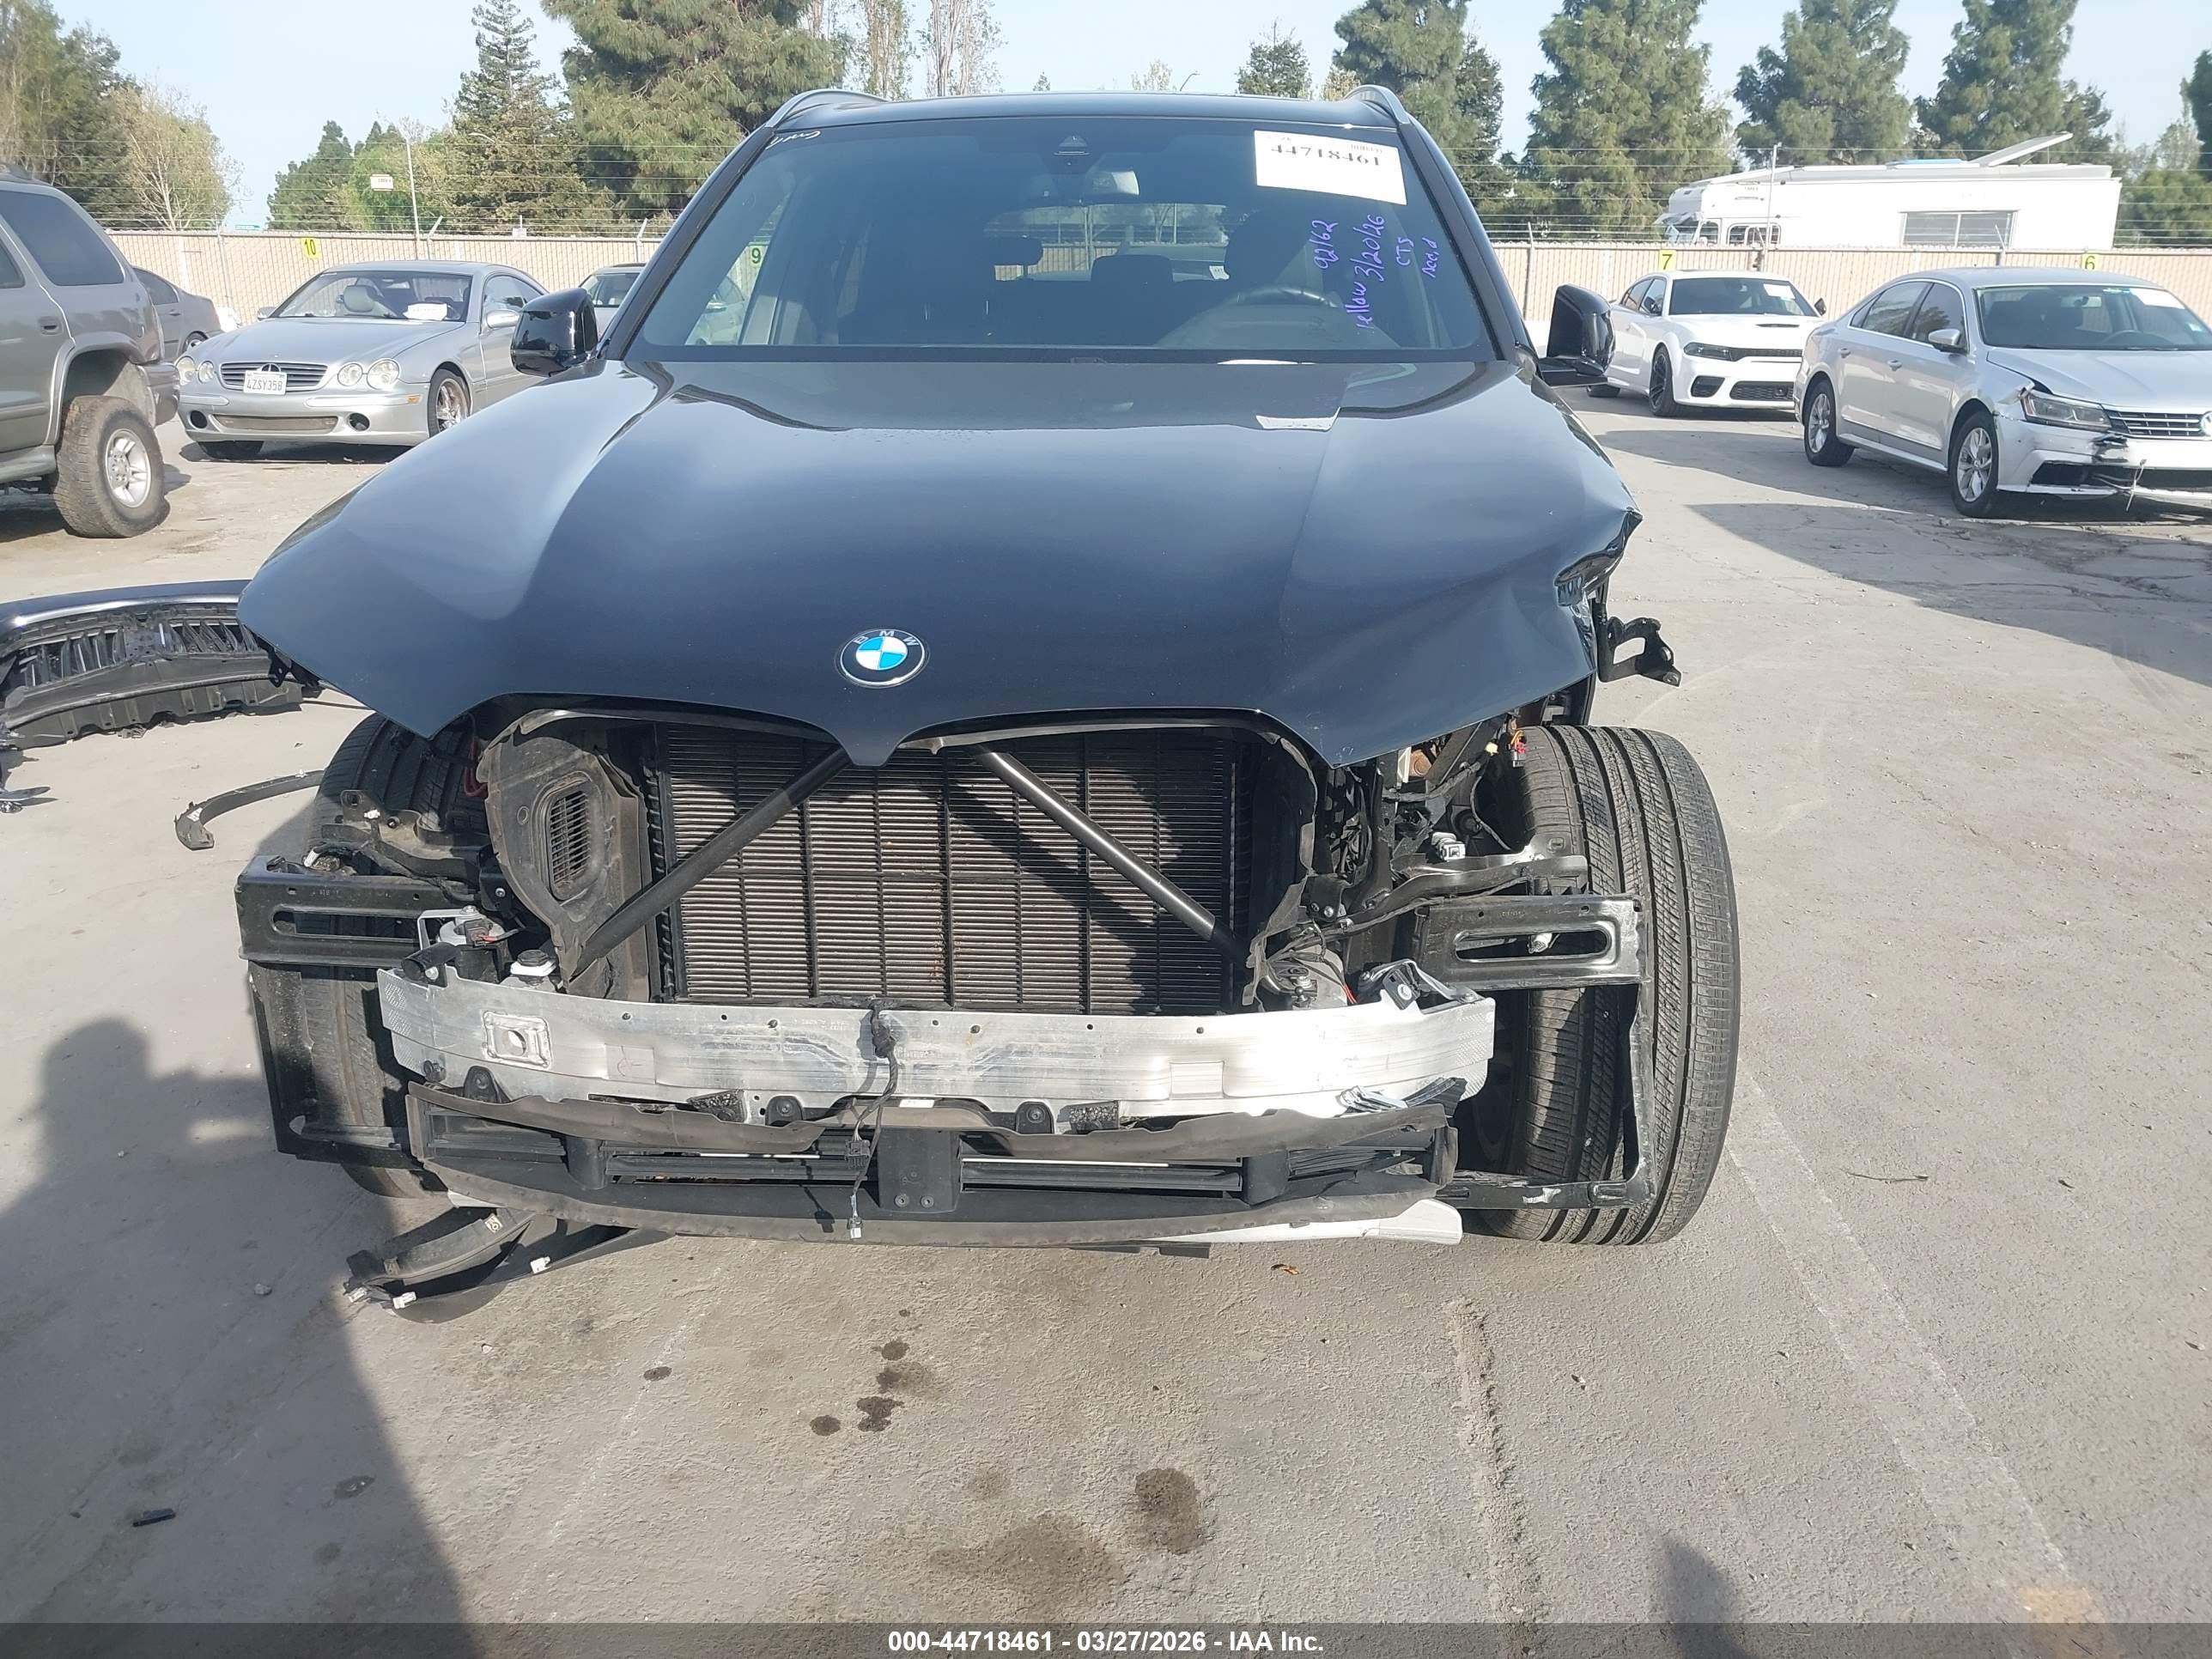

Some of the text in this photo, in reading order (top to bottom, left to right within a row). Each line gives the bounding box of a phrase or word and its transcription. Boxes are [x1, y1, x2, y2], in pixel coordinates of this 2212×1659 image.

[305, 239, 316, 256] 10
[751, 247, 761, 264] 9
[1350, 214, 1385, 282] 3/20/26
[1662, 253, 1673, 270] 7
[2084, 255, 2096, 270] 6
[853, 629, 920, 647] BMW
